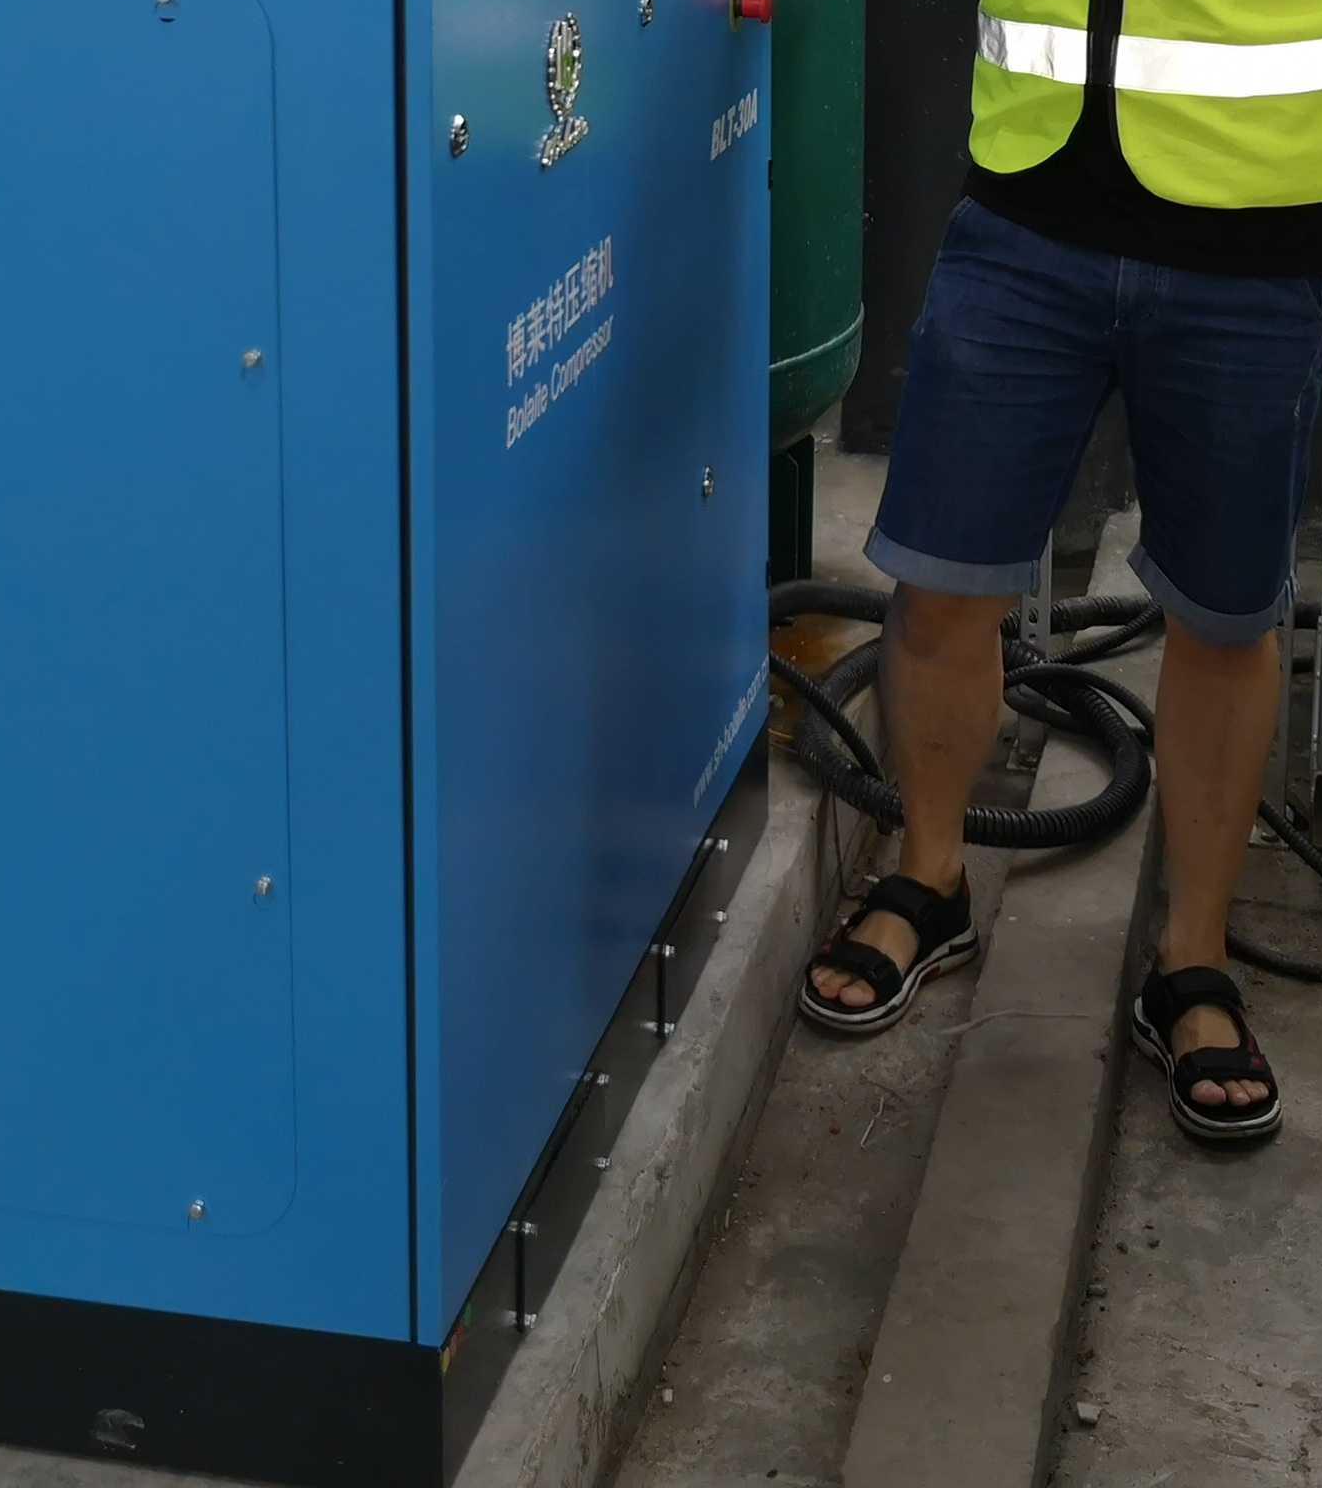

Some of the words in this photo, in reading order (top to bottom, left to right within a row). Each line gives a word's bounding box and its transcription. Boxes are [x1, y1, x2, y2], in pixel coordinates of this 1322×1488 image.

[505, 235, 615, 388] 博莱特压缩机
[505, 383, 549, 450] Bolaite
[550, 315, 615, 402] Compressor
